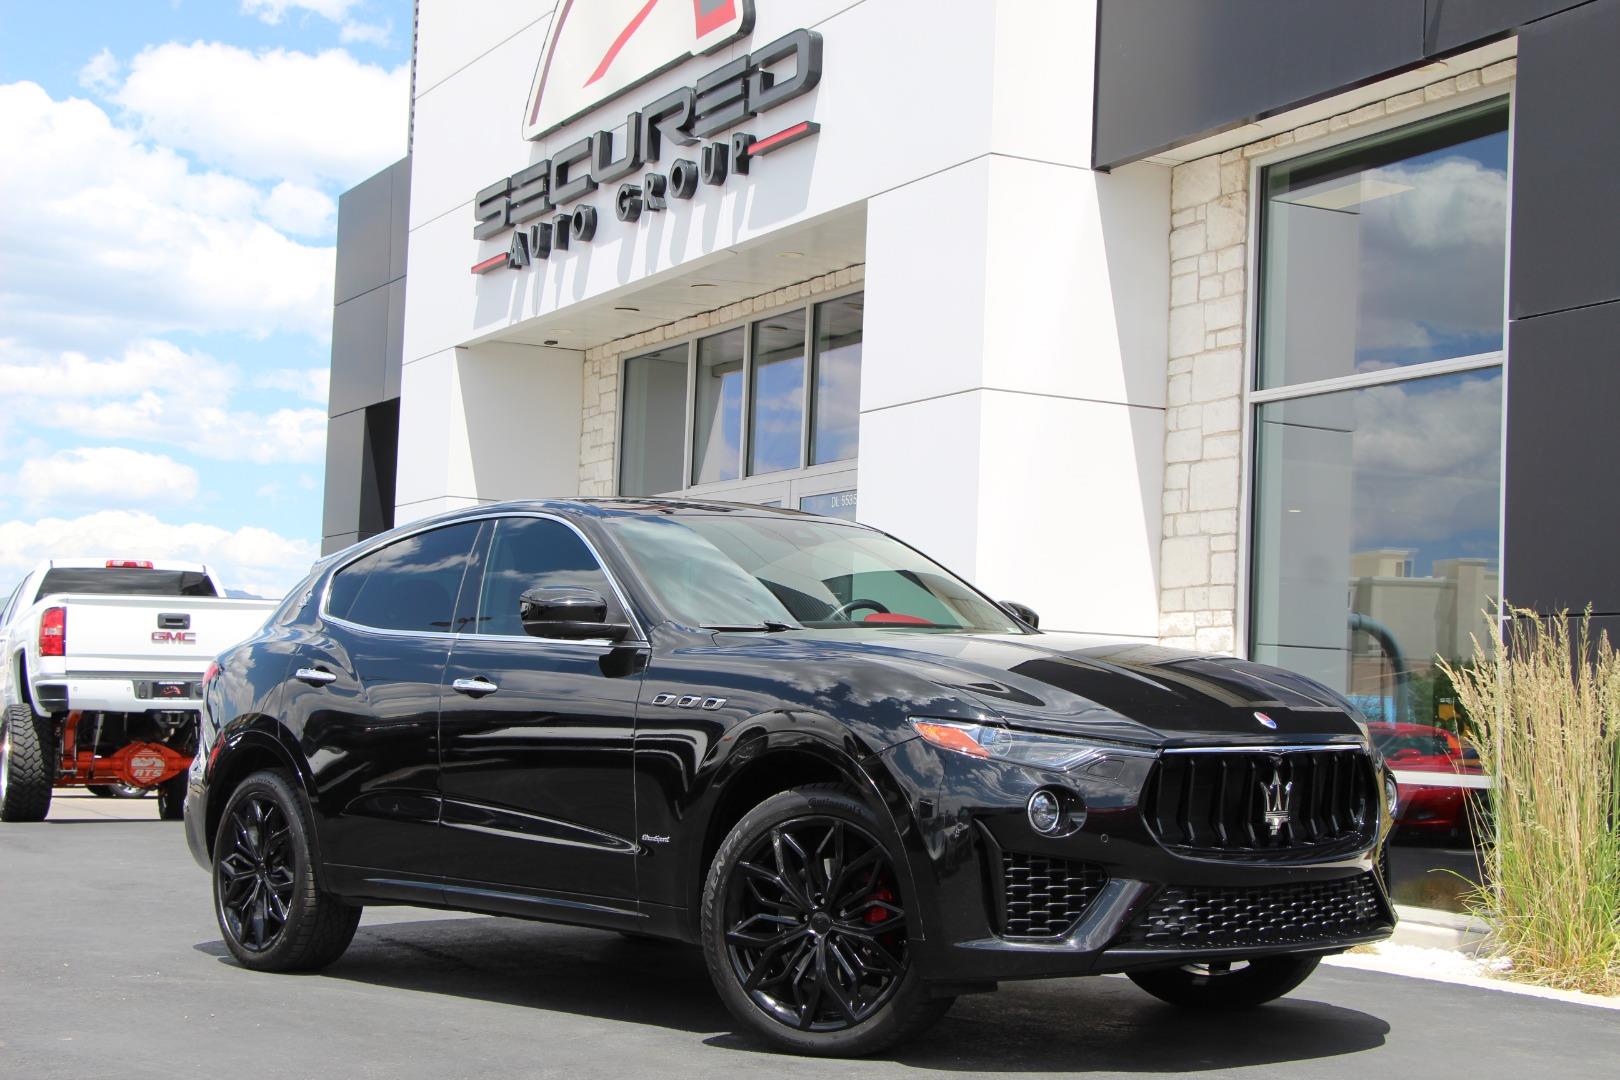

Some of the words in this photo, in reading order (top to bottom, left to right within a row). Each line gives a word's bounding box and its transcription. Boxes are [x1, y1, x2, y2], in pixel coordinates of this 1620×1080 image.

[474, 28, 823, 240] SECURED
[508, 204, 597, 269] AUTO
[615, 132, 756, 222] GROUP
[151, 631, 196, 642] GMC
